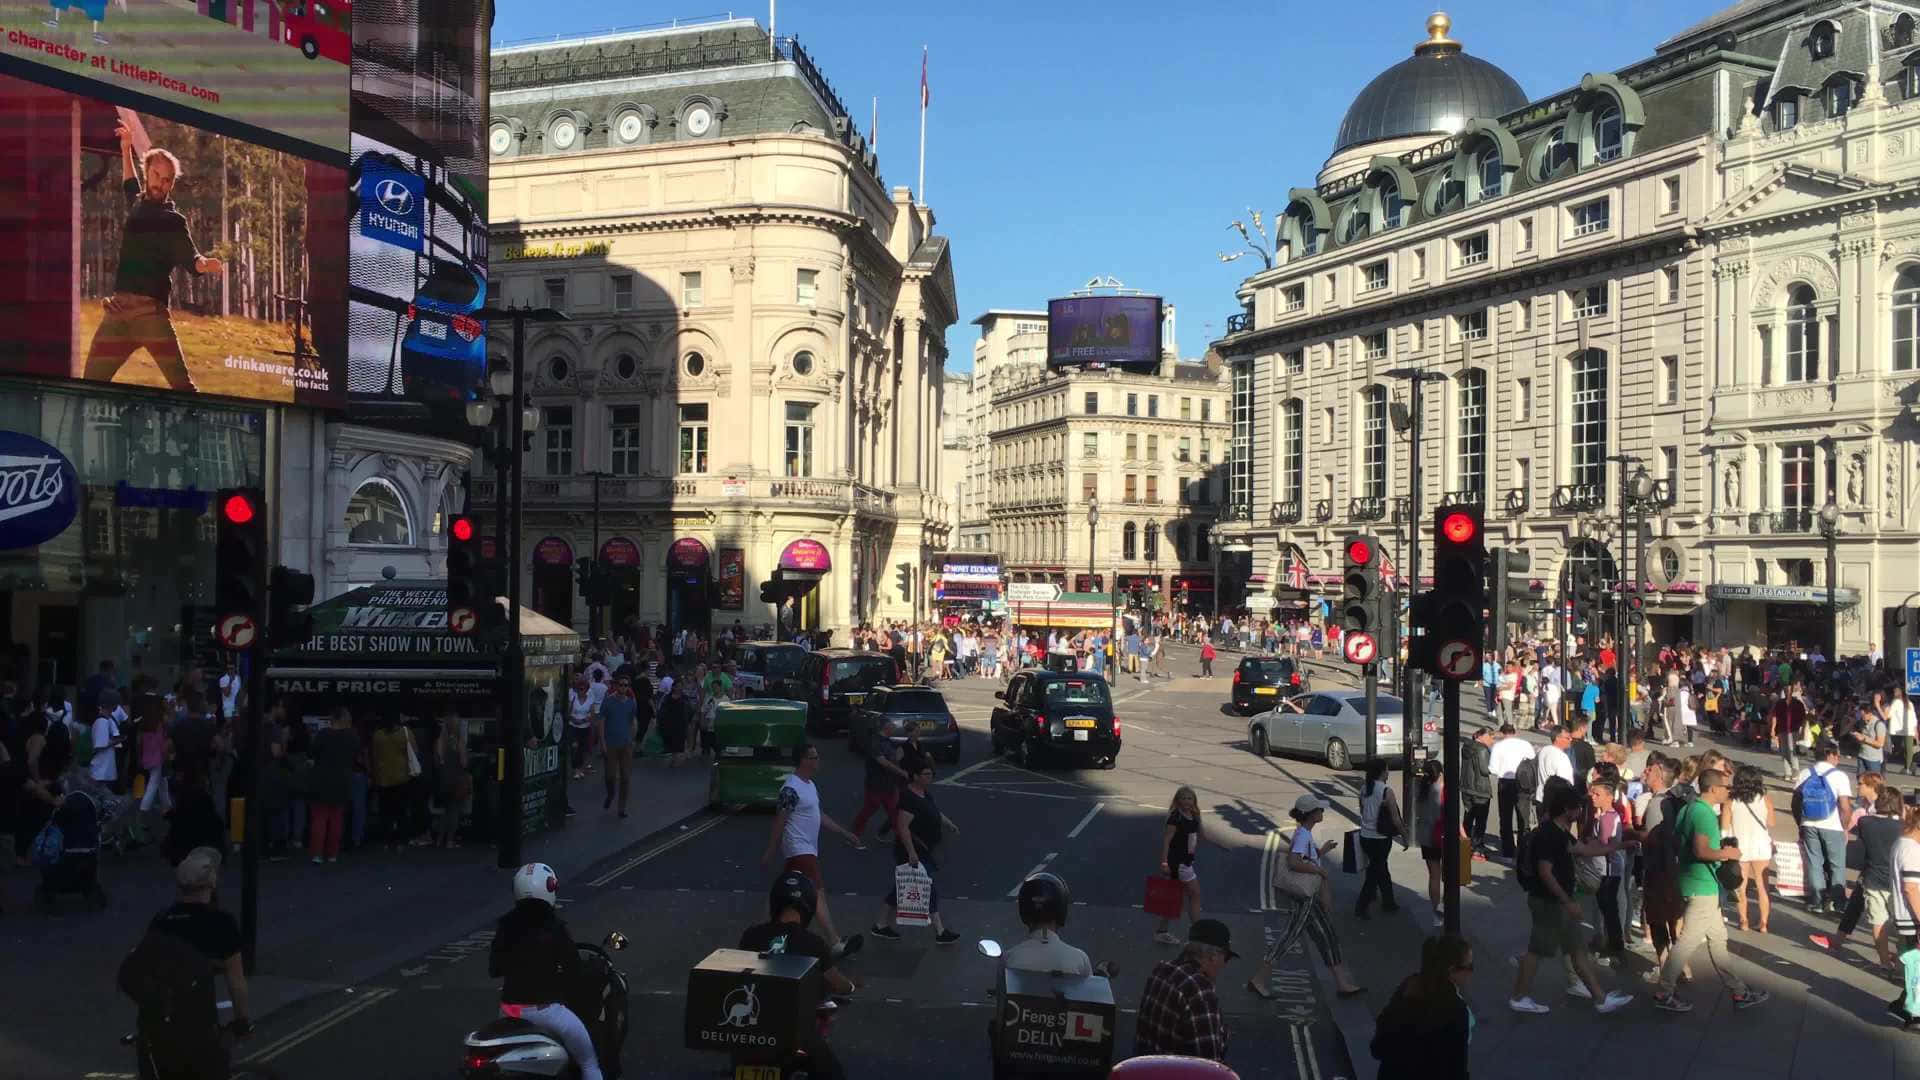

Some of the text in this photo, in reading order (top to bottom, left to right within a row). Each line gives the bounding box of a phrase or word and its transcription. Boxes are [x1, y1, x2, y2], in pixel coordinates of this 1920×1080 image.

[8, 30, 220, 104] character at LittlePicca.com
[369, 211, 418, 240] HYUNDAI
[224, 355, 329, 380] drinkaware.co.uk
[282, 376, 329, 391] for the facts
[0, 455, 63, 520] ots
[970, 565, 998, 573] EXCHANGE
[368, 596, 448, 606] PHENOMENO
[384, 590, 448, 598] THE WEST EN
[301, 635, 324, 652] HE
[330, 635, 365, 652] BEST
[370, 635, 411, 652] SHOW
[416, 635, 431, 652] IN
[274, 680, 401, 693] HALF PRICE
[1022, 1008, 1067, 1028] Feng S
[1075, 1015, 1093, 1038] L
[701, 1030, 778, 1047] DELIVEROO
